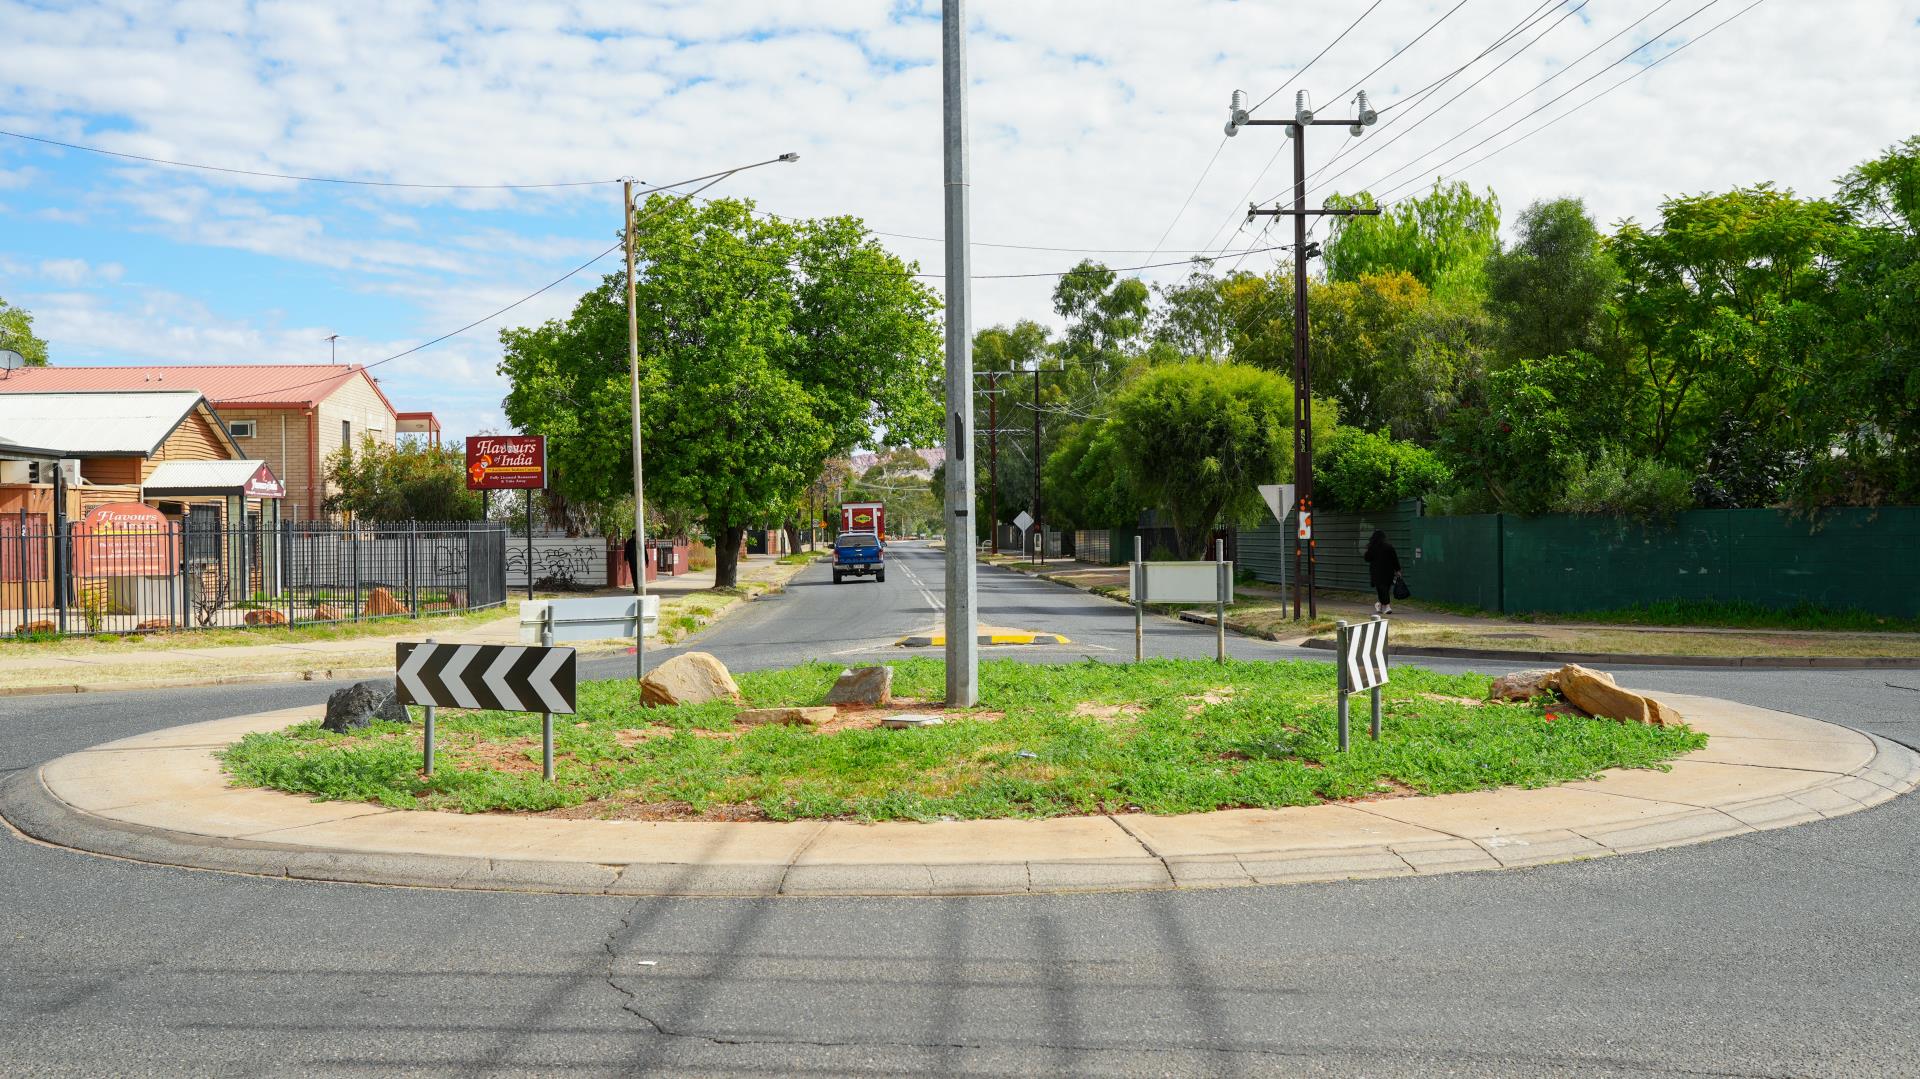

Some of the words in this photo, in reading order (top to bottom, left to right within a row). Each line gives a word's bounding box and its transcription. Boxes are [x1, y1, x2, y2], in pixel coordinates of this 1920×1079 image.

[476, 440, 536, 456] Flavours
[501, 453, 533, 466] India
[97, 511, 158, 521] Flavours
